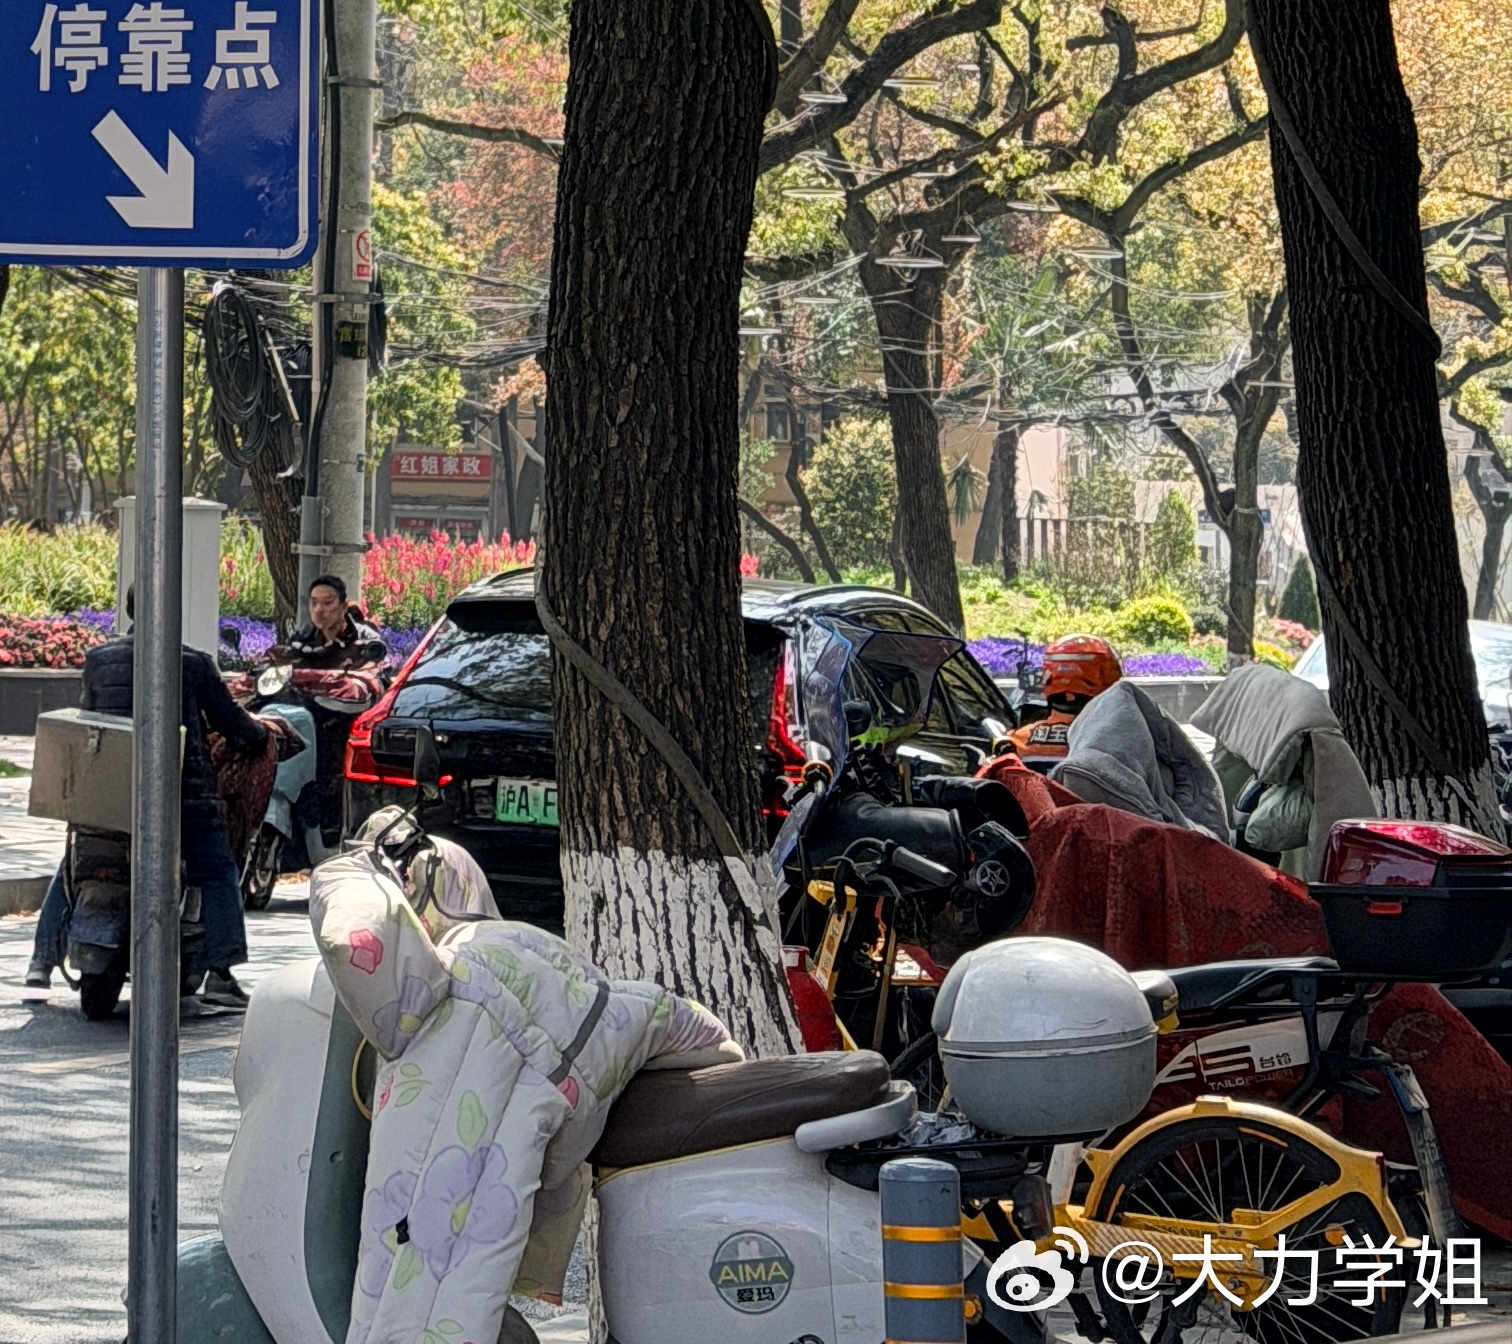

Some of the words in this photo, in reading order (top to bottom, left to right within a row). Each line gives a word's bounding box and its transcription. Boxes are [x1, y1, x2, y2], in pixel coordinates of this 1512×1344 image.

[30, 0, 280, 93] 停靠点
[400, 455, 481, 476] 红姐家政
[716, 1260, 790, 1285] AIMA
